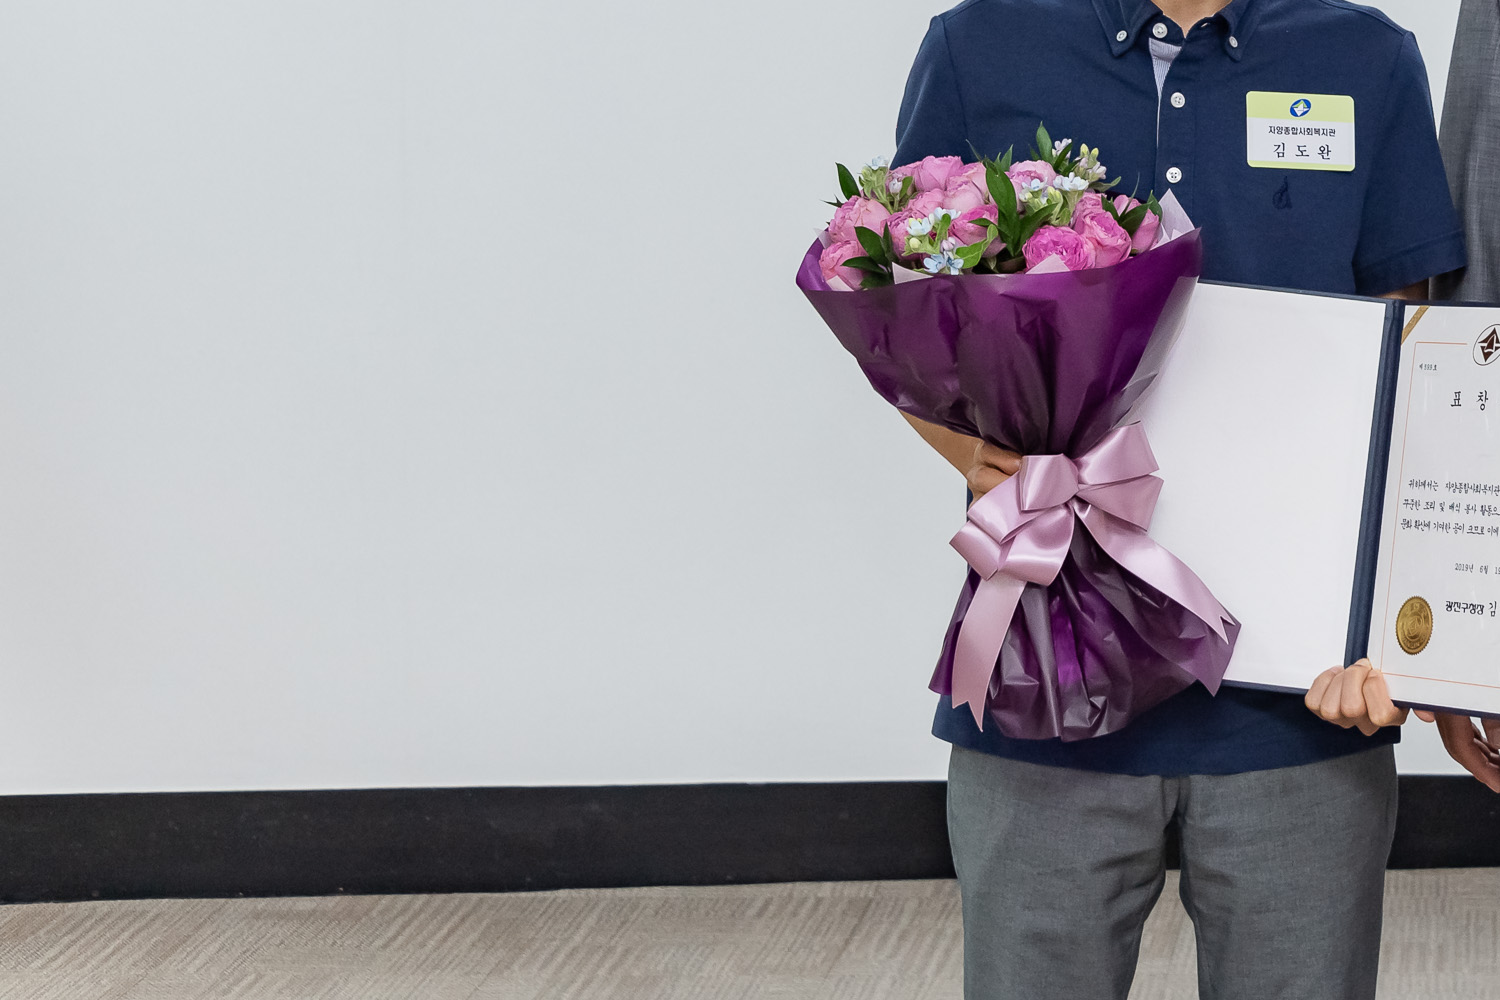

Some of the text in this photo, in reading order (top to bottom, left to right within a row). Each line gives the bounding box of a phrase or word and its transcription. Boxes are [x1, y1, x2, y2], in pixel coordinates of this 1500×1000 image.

[1268, 125, 1336, 137] 자양종합사회복지관
[1423, 501, 1436, 512] 조리
[1454, 562, 1474, 574] 2019년
[1479, 565, 1489, 574] 6월
[1445, 600, 1485, 615] 광진구청장
